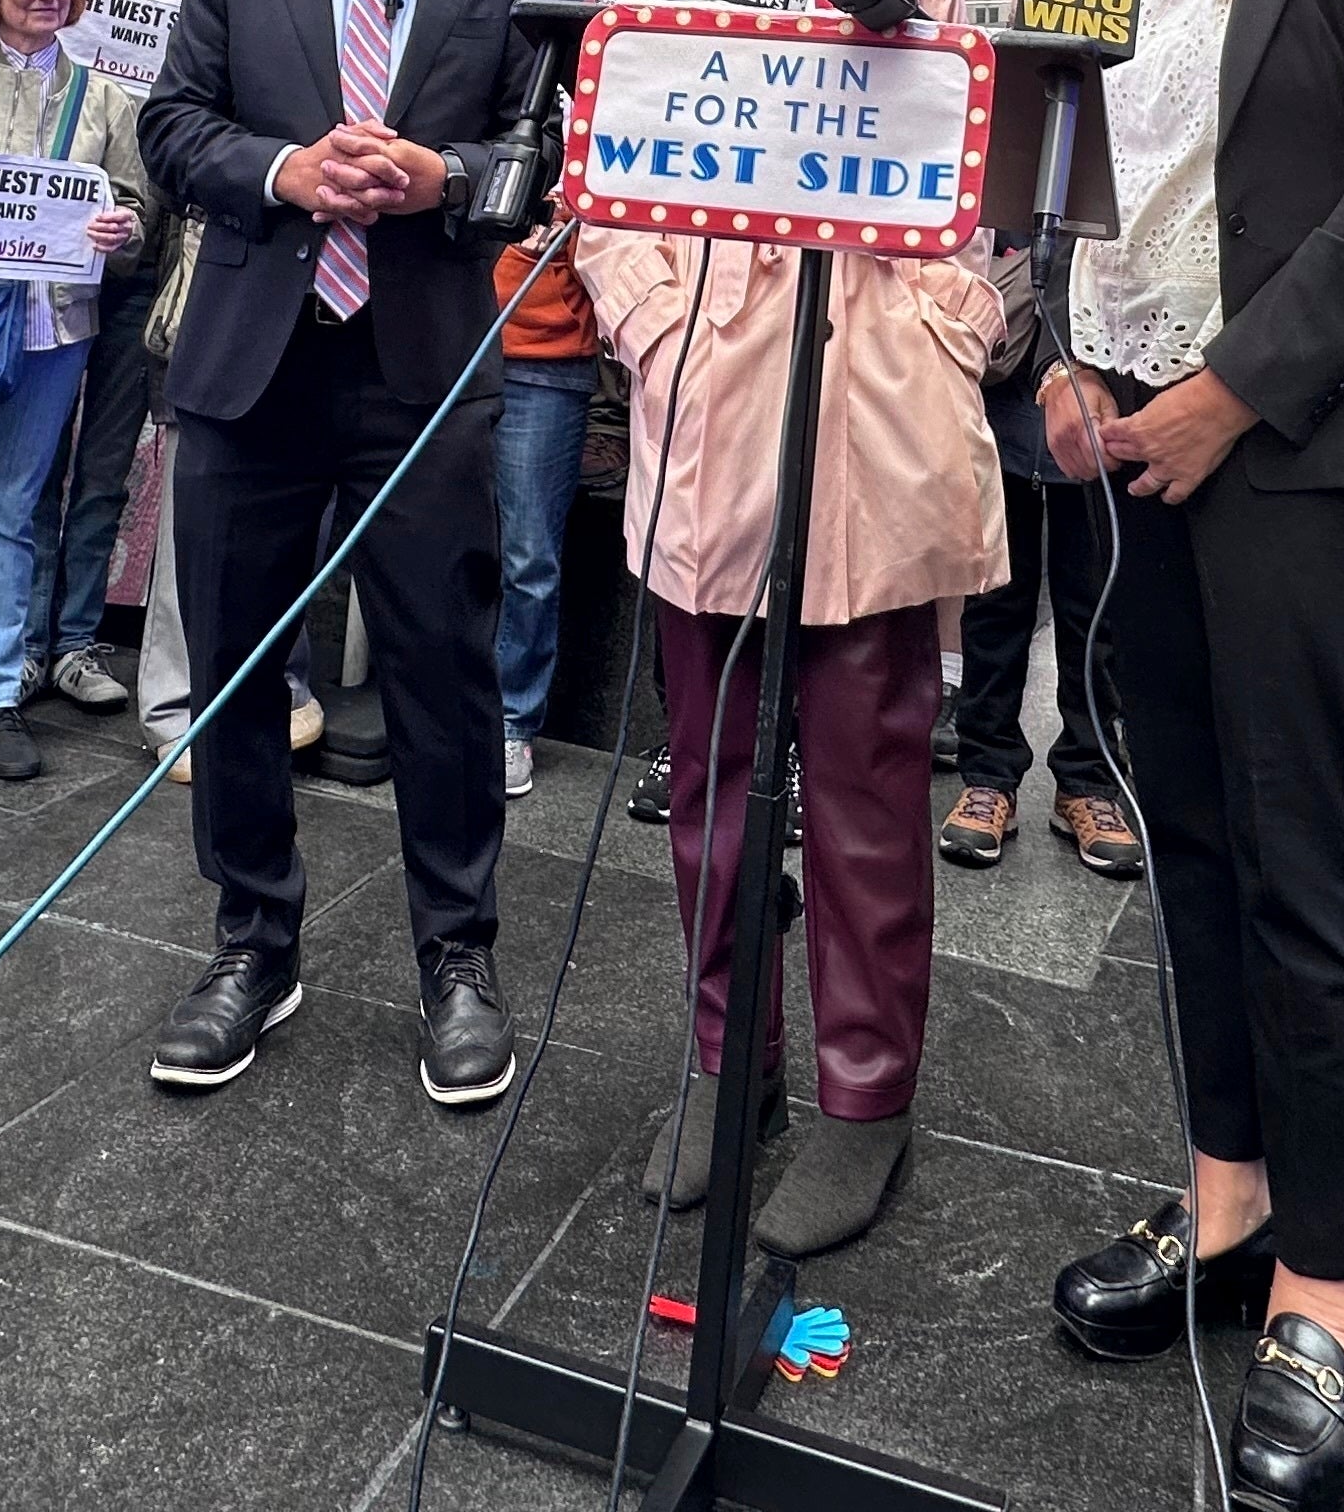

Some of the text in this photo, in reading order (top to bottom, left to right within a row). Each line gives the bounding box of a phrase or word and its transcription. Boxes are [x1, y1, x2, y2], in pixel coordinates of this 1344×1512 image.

[111, 25, 159, 49] WANTS
[700, 51, 870, 92] A WIN
[664, 91, 881, 140] FOR THE
[593, 132, 955, 202] WEST SIDE
[46, 174, 100, 203] SIDE
